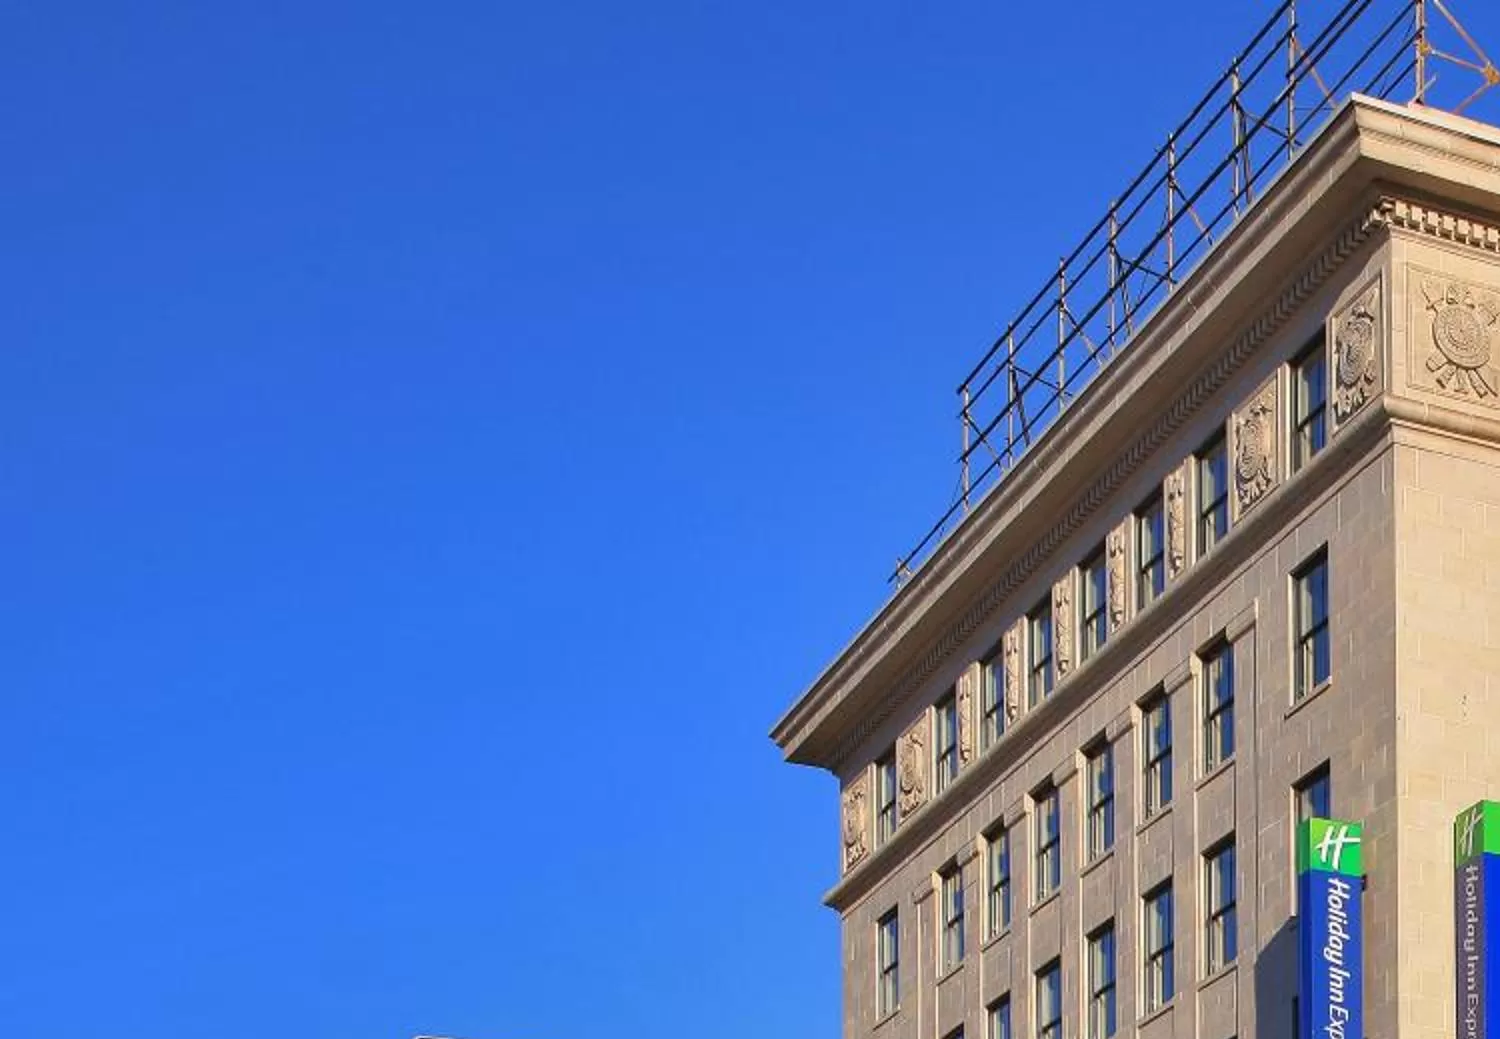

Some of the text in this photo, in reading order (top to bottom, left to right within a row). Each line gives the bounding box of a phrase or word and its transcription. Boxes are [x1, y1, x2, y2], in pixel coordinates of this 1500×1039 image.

[1323, 877, 1351, 966] Holiday
[1463, 863, 1480, 953] Holiday
[1328, 966, 1351, 1003] Inn
[1466, 954, 1480, 991] Inn
